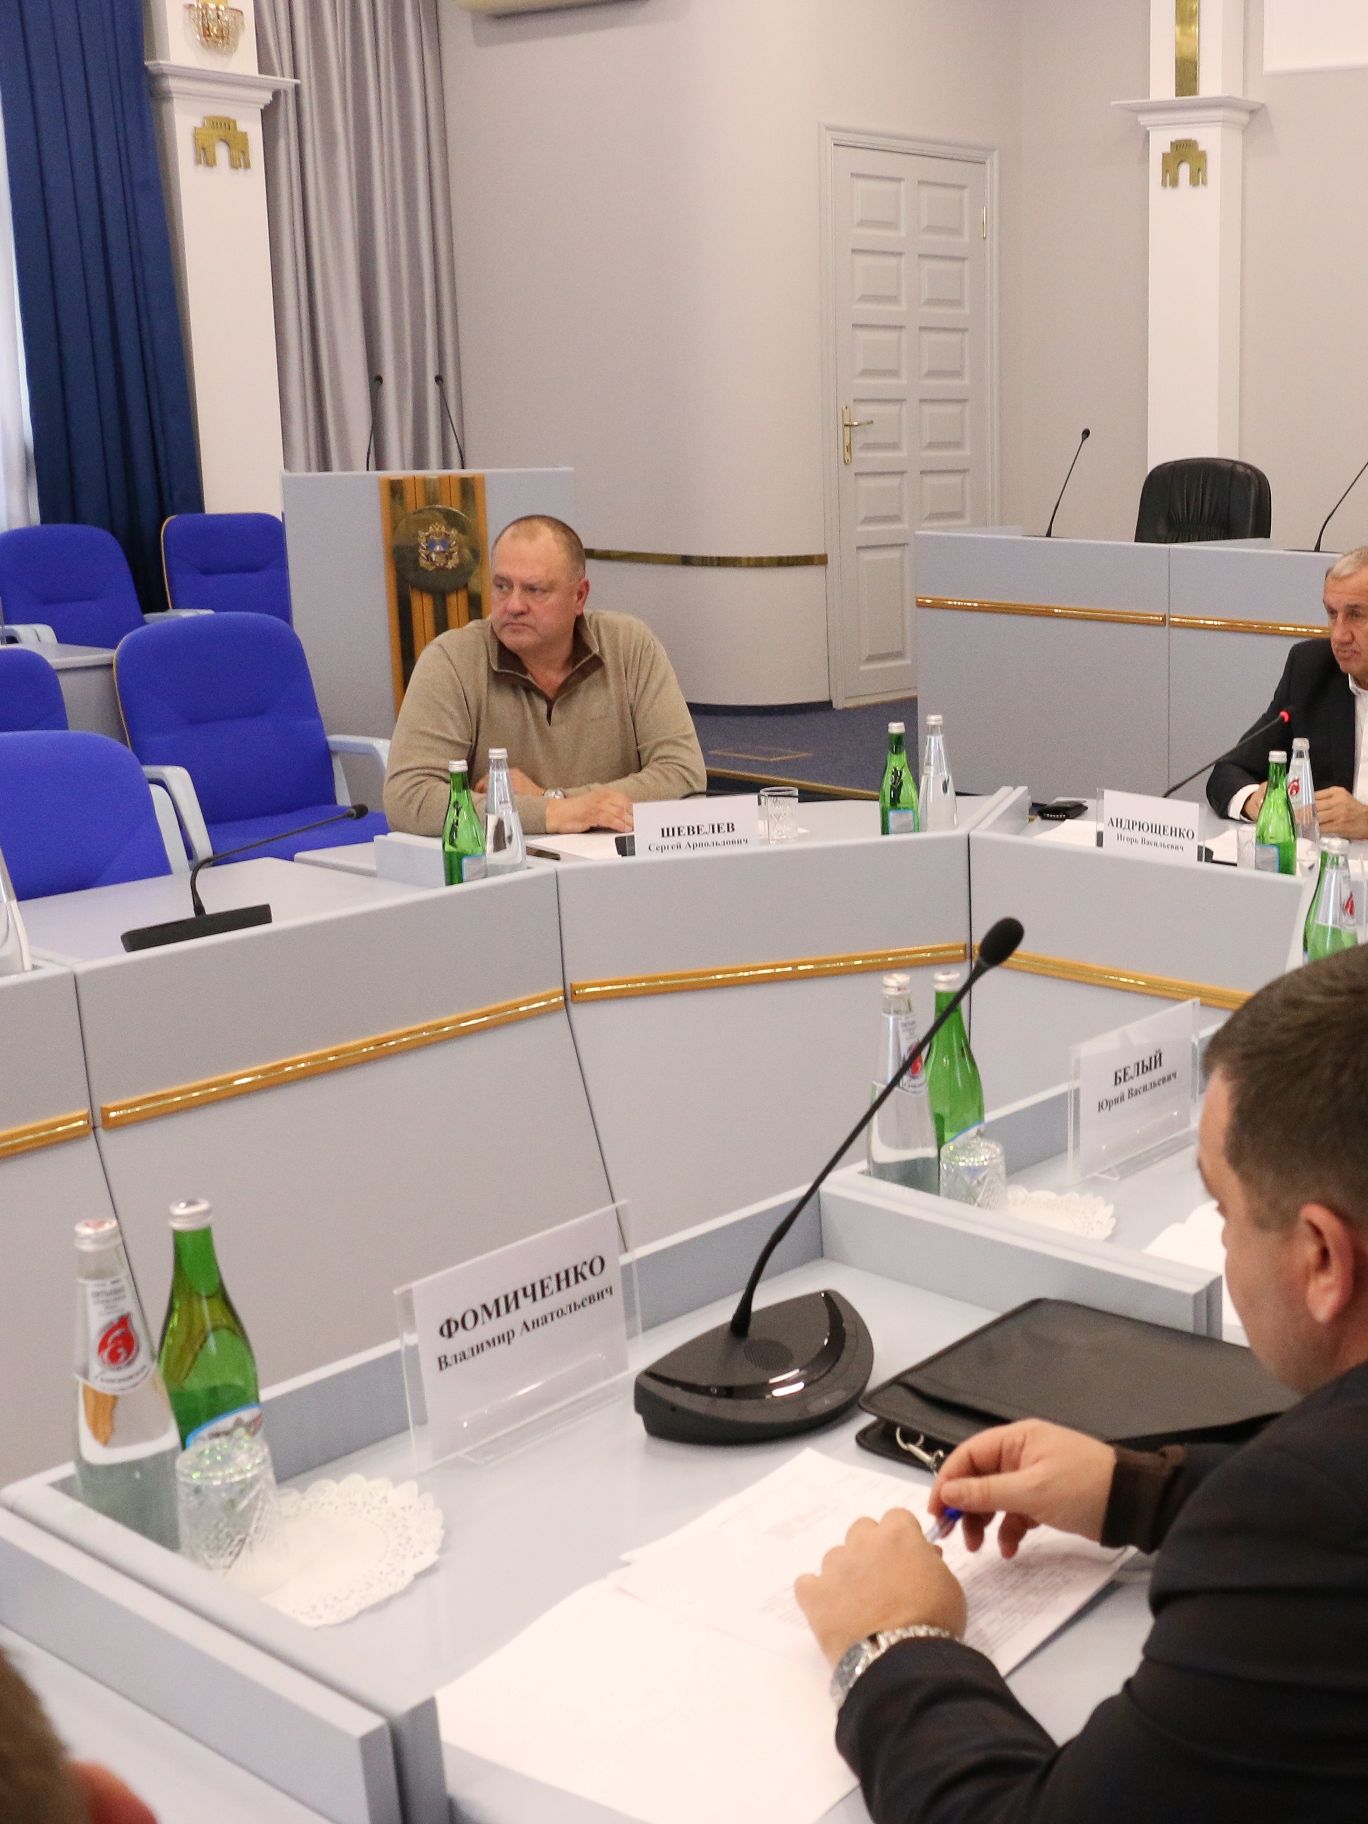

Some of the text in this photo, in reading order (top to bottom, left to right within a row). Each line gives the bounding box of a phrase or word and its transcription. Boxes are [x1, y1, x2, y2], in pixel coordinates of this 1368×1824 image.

[661, 822, 735, 838] ШЕВЕЛЕВ
[1107, 817, 1195, 840] АНДРЮЩЕНКО
[1116, 833, 1184, 852] Игорь Васильевич
[648, 842, 682, 853] Сергей
[1114, 1049, 1163, 1086] БЕЛЫЙ
[1097, 1071, 1178, 1113] Юрий Васильевич
[438, 1255, 606, 1340] ФОМИЧЕНКО
[436, 1285, 614, 1372] Владимир Анатольевич
